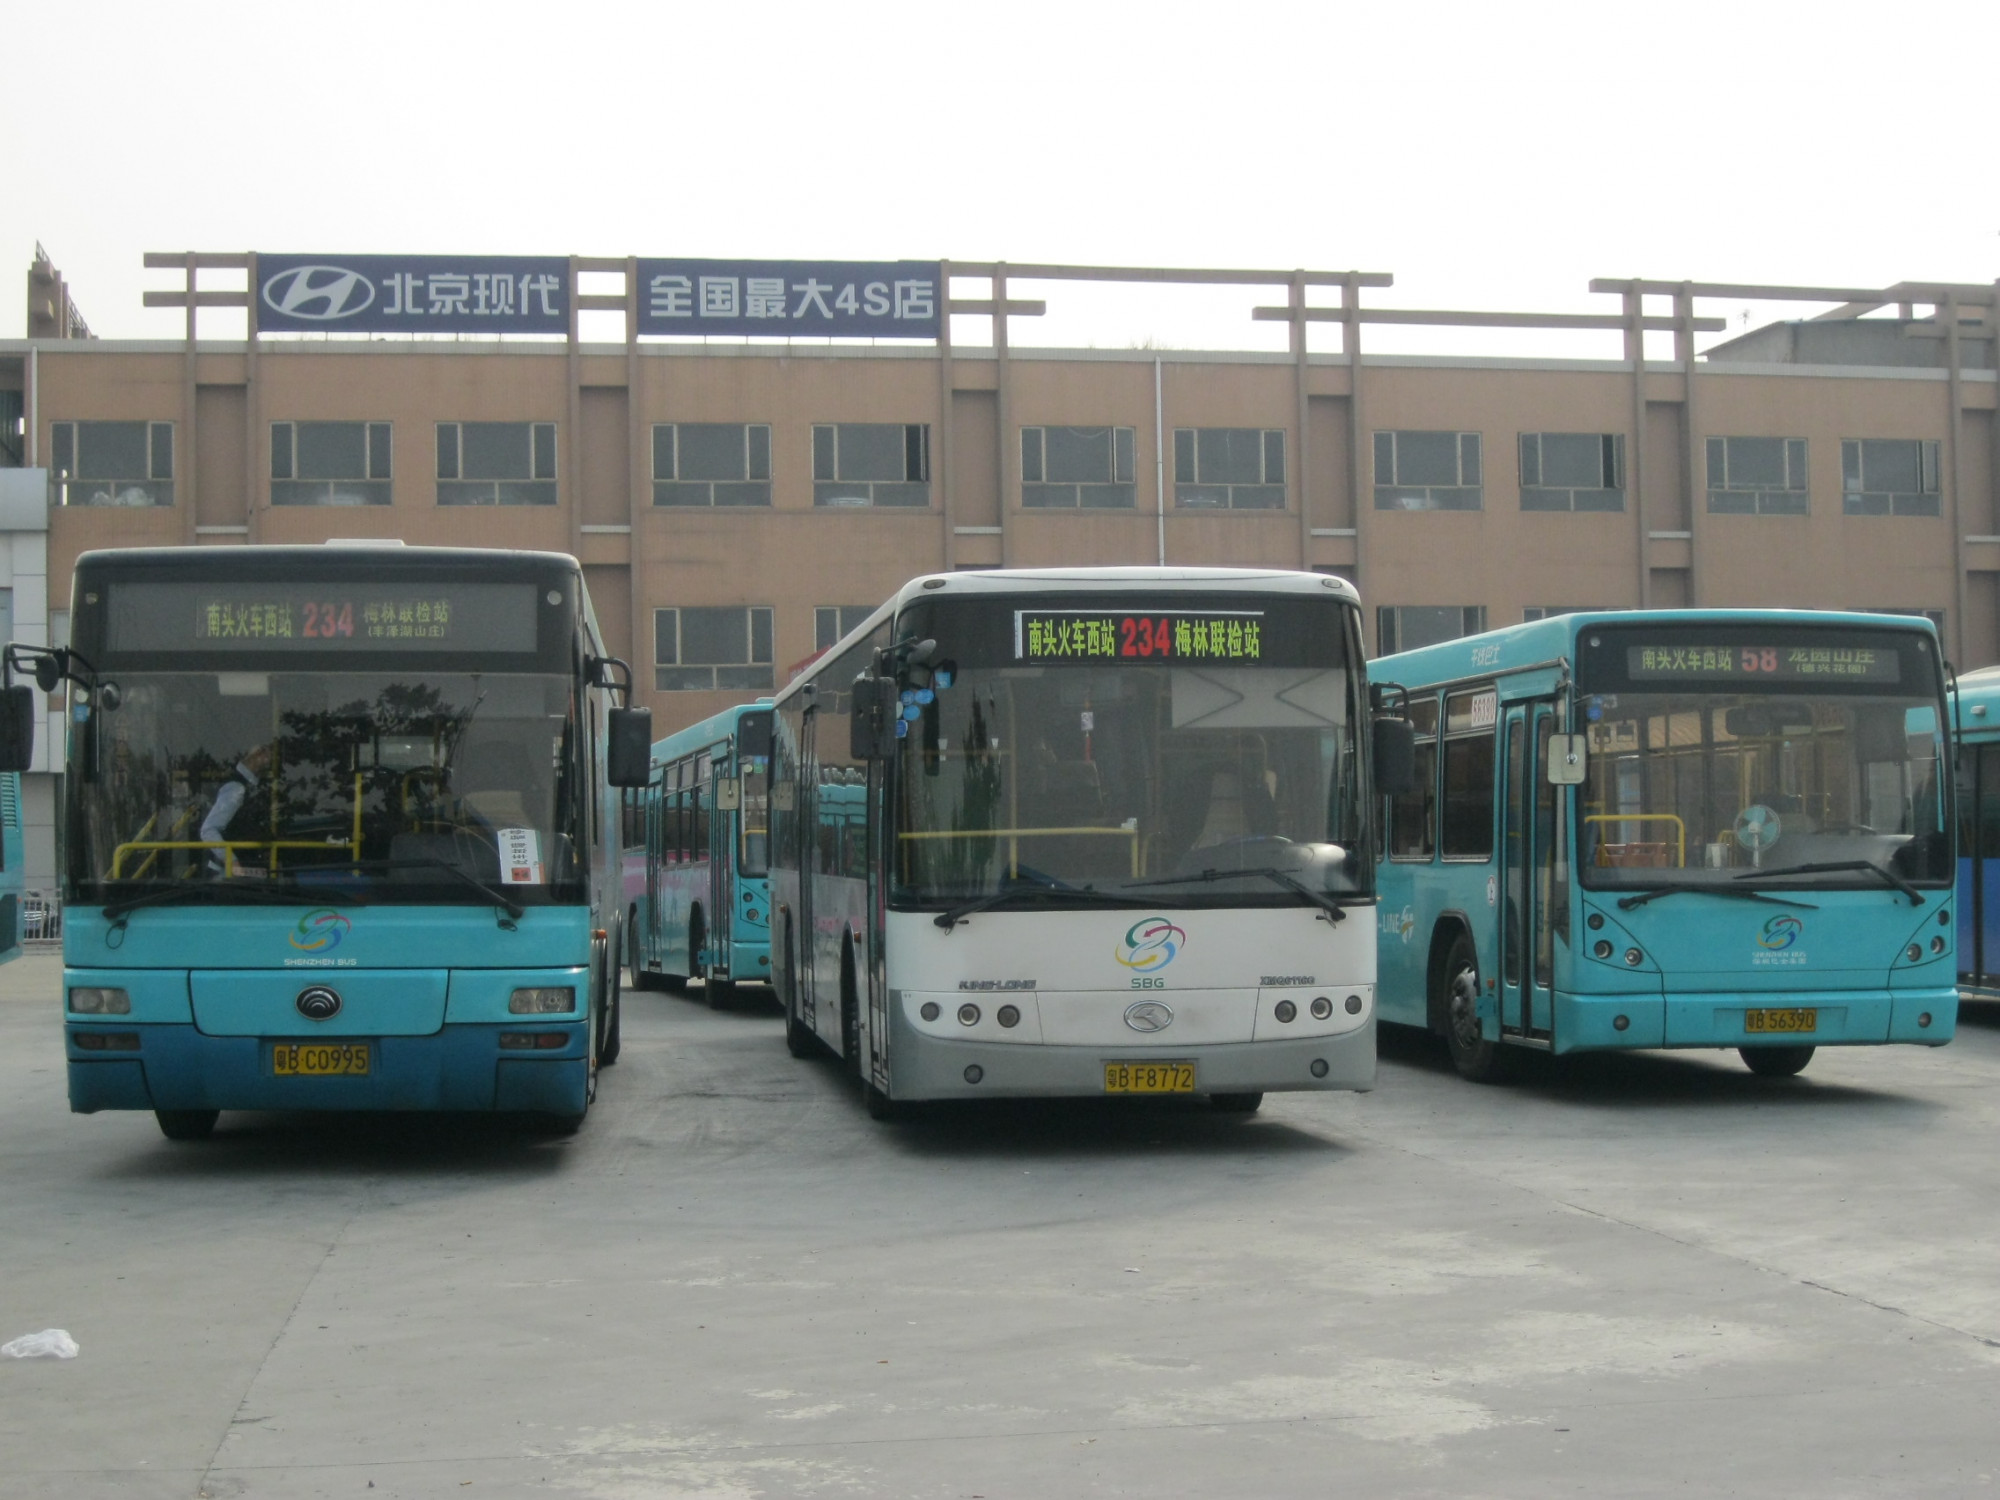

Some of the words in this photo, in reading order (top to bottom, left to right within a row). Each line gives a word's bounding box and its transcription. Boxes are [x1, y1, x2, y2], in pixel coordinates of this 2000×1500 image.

[382, 272, 560, 317] 北京现代
[650, 275, 935, 320] 全国最大4S店
[206, 602, 292, 638] 南头火车西站
[303, 602, 354, 638] 234
[1028, 618, 1115, 657] 南头火车西站
[1121, 618, 1171, 657] 234
[1175, 619, 1260, 658] 梅林联检站
[1641, 646, 1732, 672] 南头火车西站
[1741, 646, 1778, 673] 58
[283, 958, 335, 966] SHENZHEN
[337, 958, 357, 966] BUS
[1131, 977, 1164, 989] SBG
